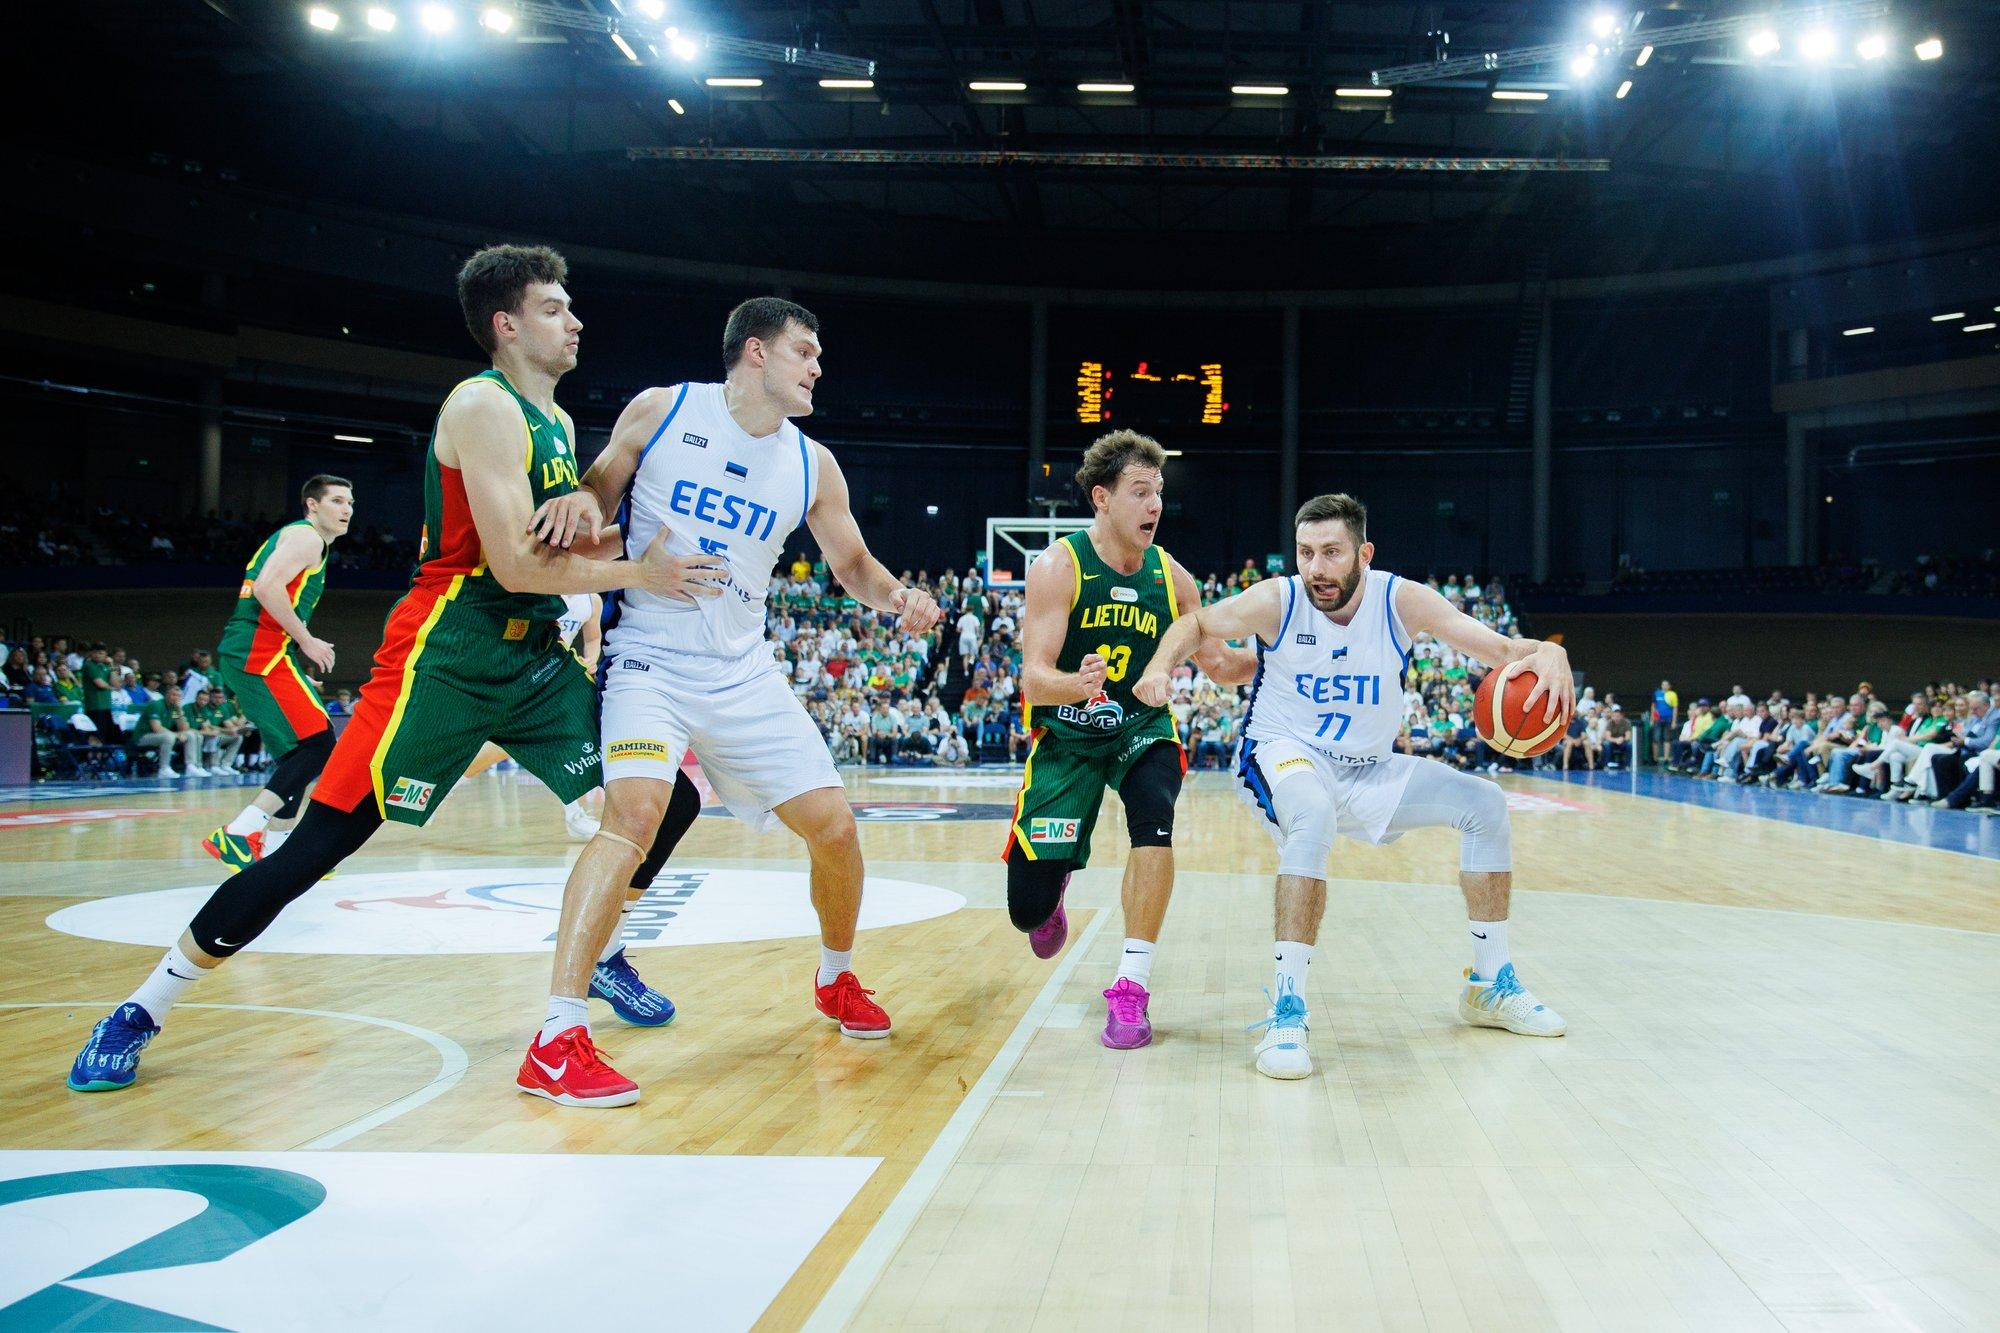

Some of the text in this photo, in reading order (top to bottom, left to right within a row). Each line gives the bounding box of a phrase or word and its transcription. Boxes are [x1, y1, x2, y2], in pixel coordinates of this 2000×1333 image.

[684, 434, 707, 447] BALLZY
[1042, 463, 1051, 477] 7
[669, 479, 778, 542] EESTI
[1080, 603, 1158, 640] LIETUVA
[1295, 673, 1380, 706] EESTI
[1058, 704, 1123, 730] BIOVE
[1315, 711, 1352, 742] 77
[610, 742, 665, 754] RAMIRENT
